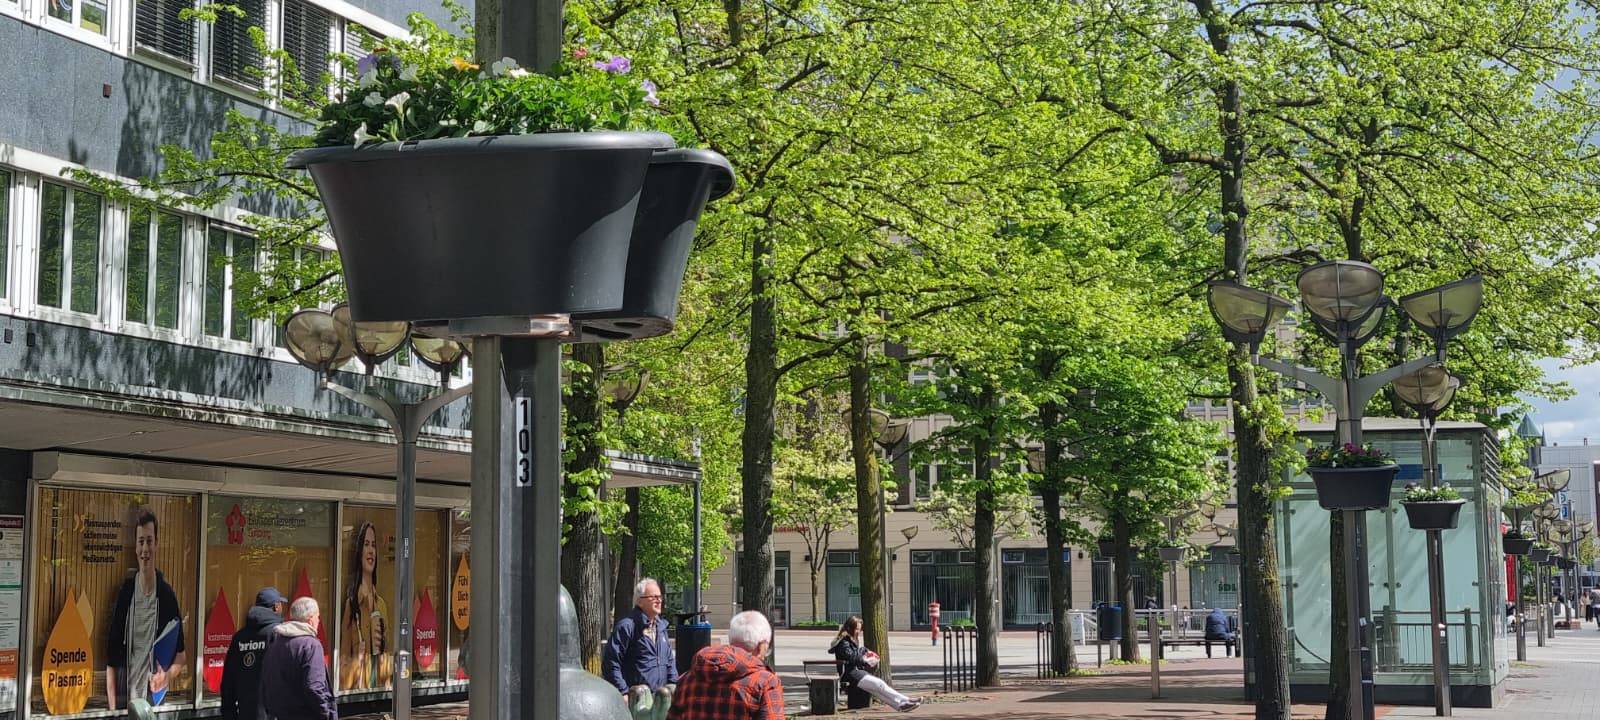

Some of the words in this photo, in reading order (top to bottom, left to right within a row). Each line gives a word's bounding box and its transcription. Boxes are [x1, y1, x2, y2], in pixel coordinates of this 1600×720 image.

[519, 399, 530, 484] 103
[416, 629, 436, 642] Spende
[50, 648, 87, 667] Spende
[419, 645, 432, 657] Blut!
[48, 671, 87, 689] Plasma!
